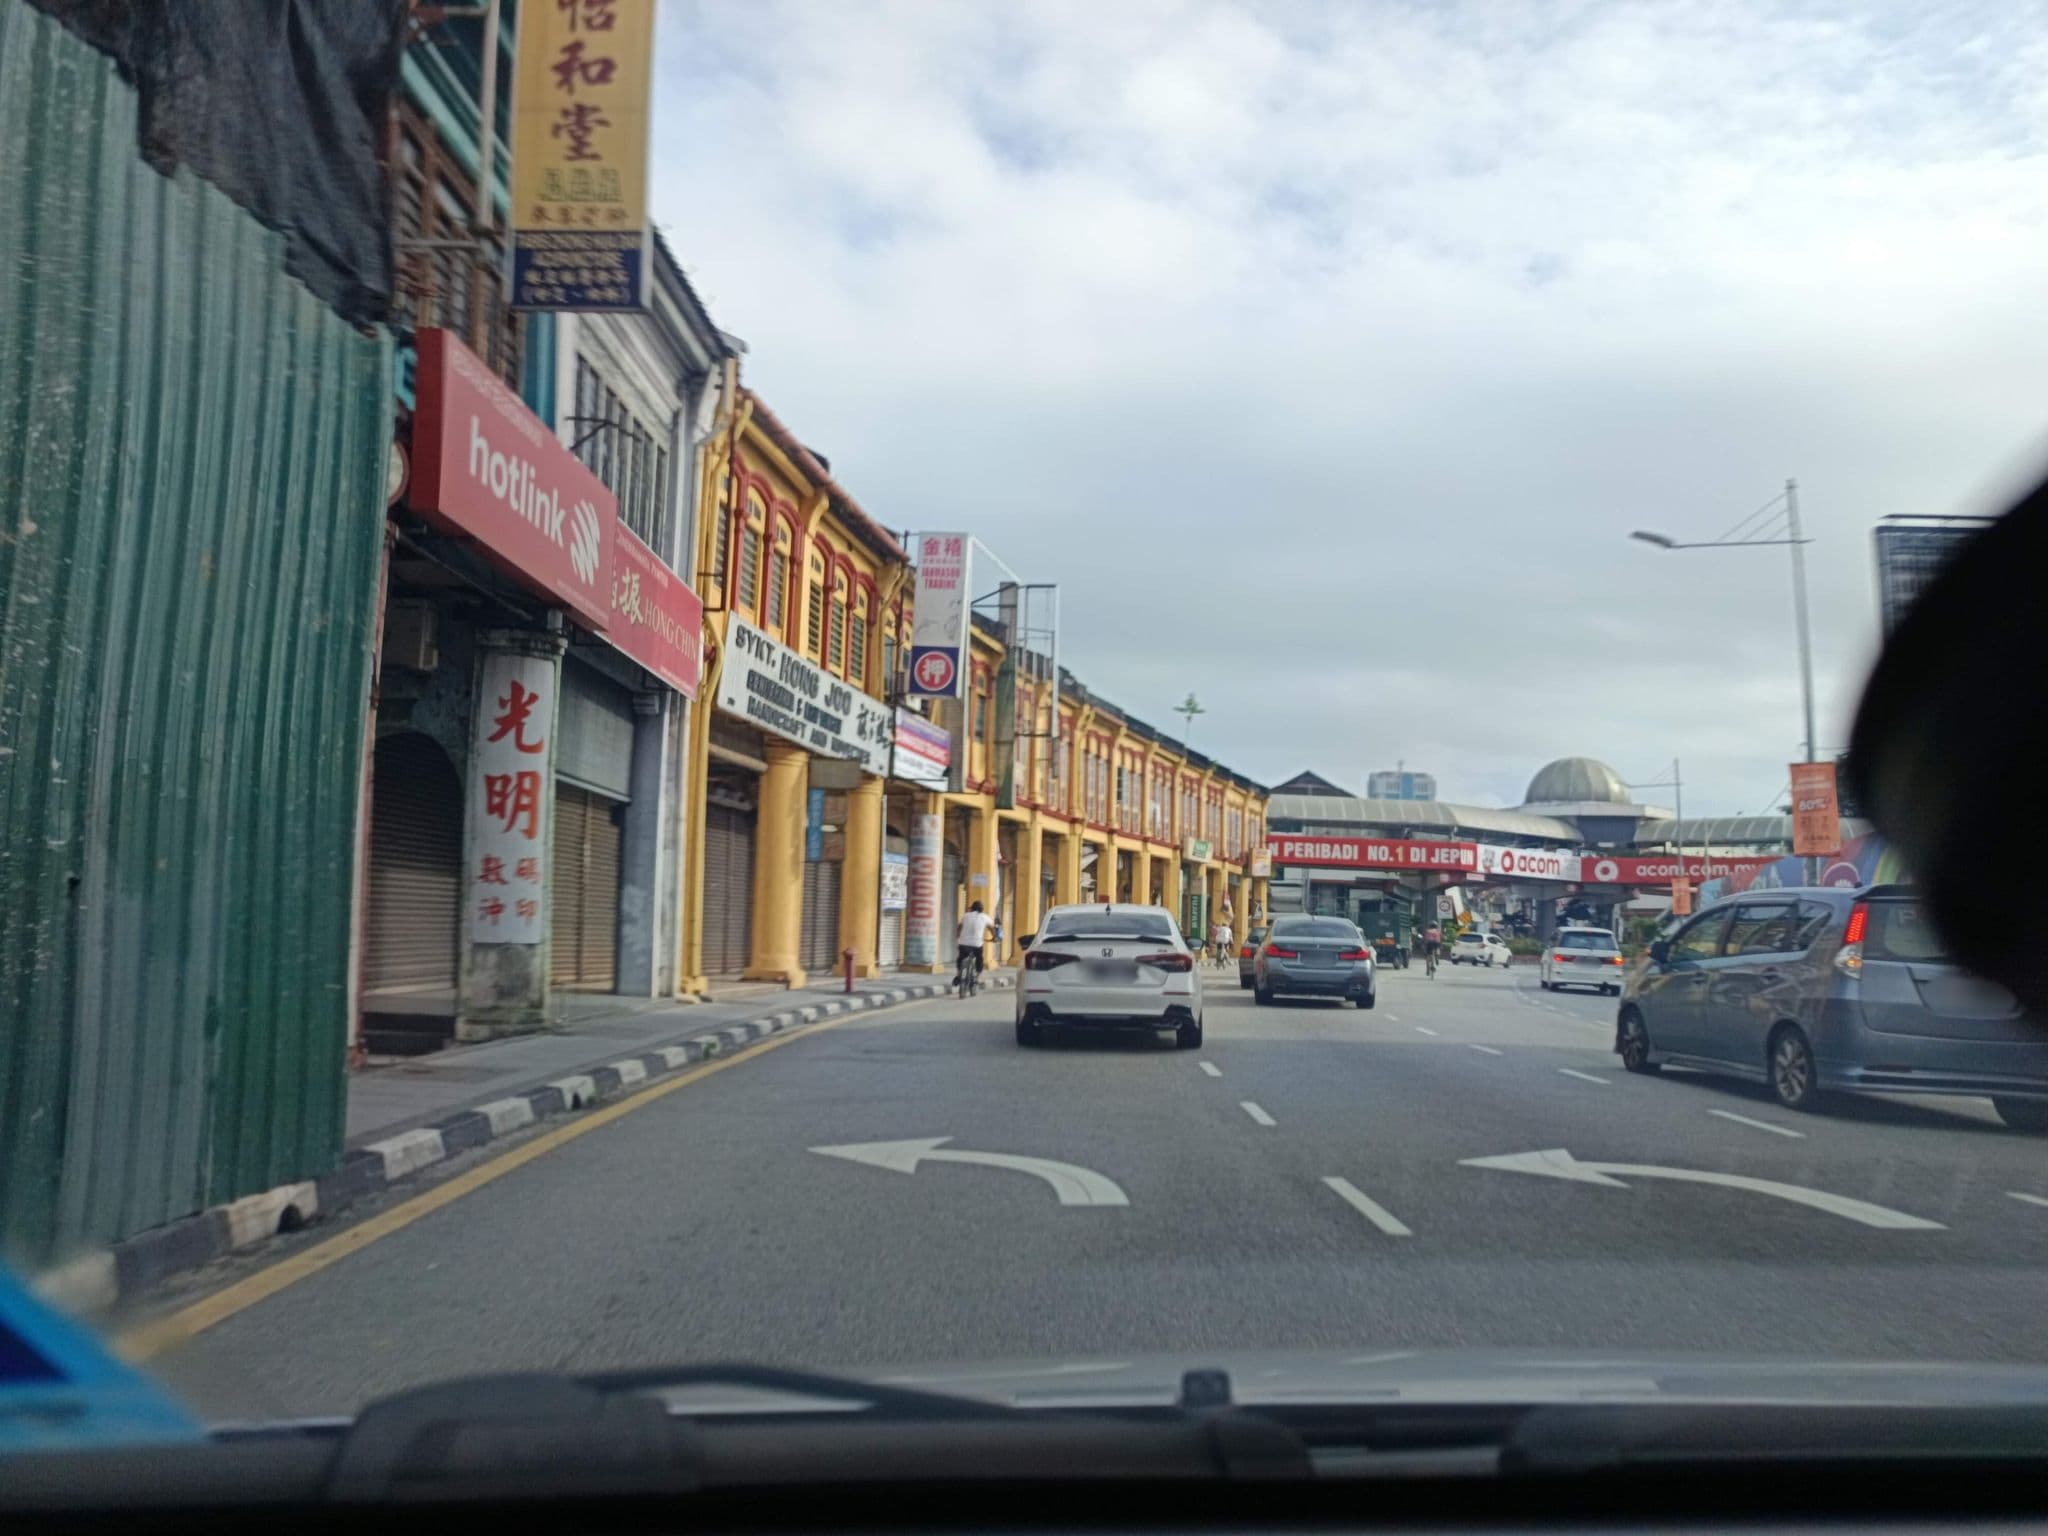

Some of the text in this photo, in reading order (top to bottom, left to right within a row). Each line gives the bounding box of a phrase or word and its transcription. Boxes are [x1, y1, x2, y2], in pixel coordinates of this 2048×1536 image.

[469, 415, 566, 549] hotlink
[644, 598, 674, 644] HONG
[675, 624, 698, 664] CHIN
[735, 623, 776, 668] SYKT.
[779, 652, 819, 699] HONG
[922, 659, 945, 685] 押
[484, 680, 545, 840] 光明
[1283, 841, 1360, 860] PERIBADI
[1367, 845, 1404, 861] NO.1
[1410, 847, 1426, 863] DI
[1431, 848, 1474, 865] JEPUN
[1518, 854, 1561, 875] acom
